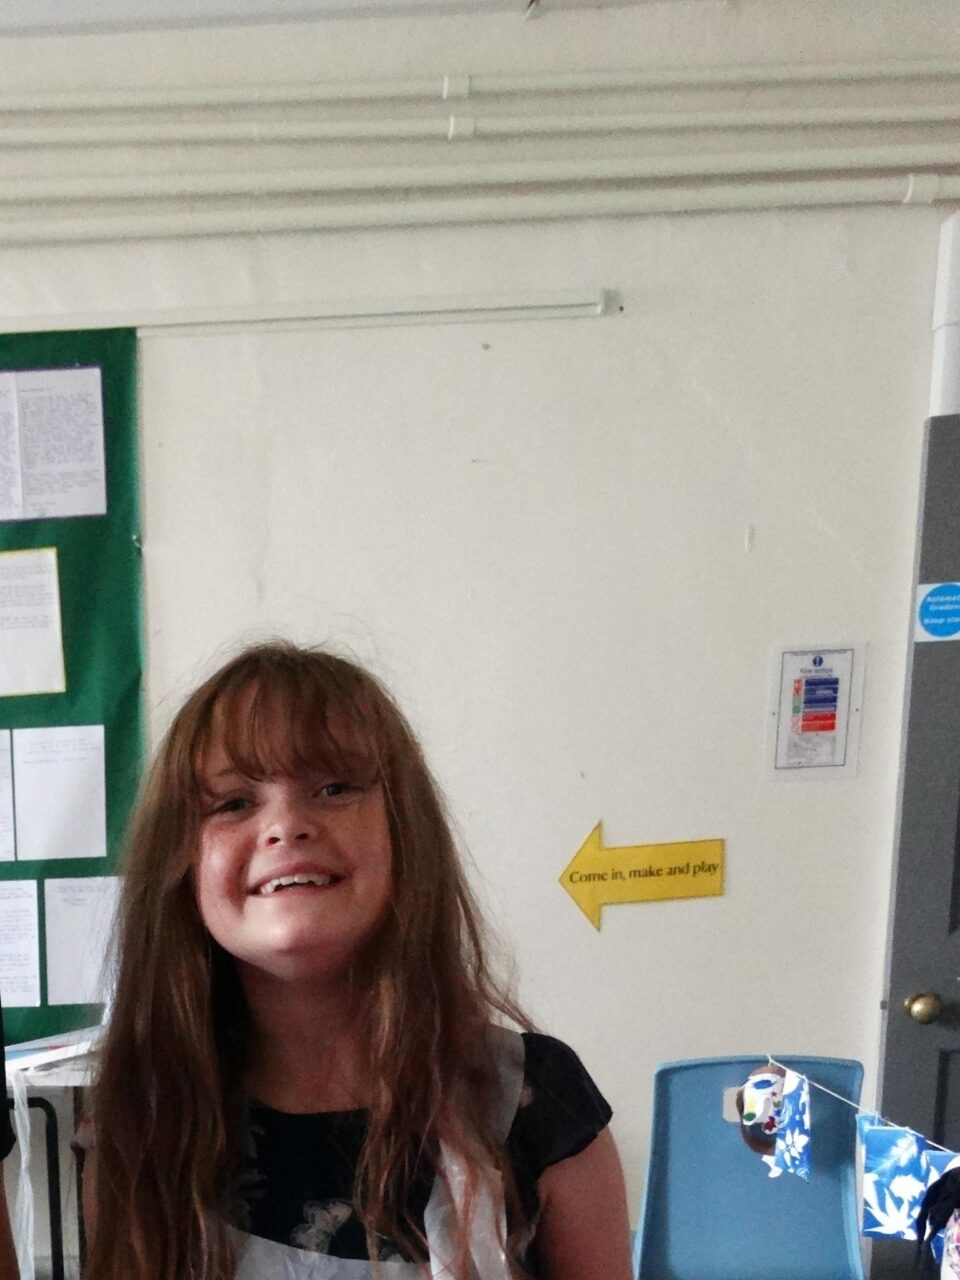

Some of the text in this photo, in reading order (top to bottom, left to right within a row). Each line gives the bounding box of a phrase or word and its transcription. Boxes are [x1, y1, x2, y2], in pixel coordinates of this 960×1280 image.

[569, 860, 720, 884] Come in, make and play
